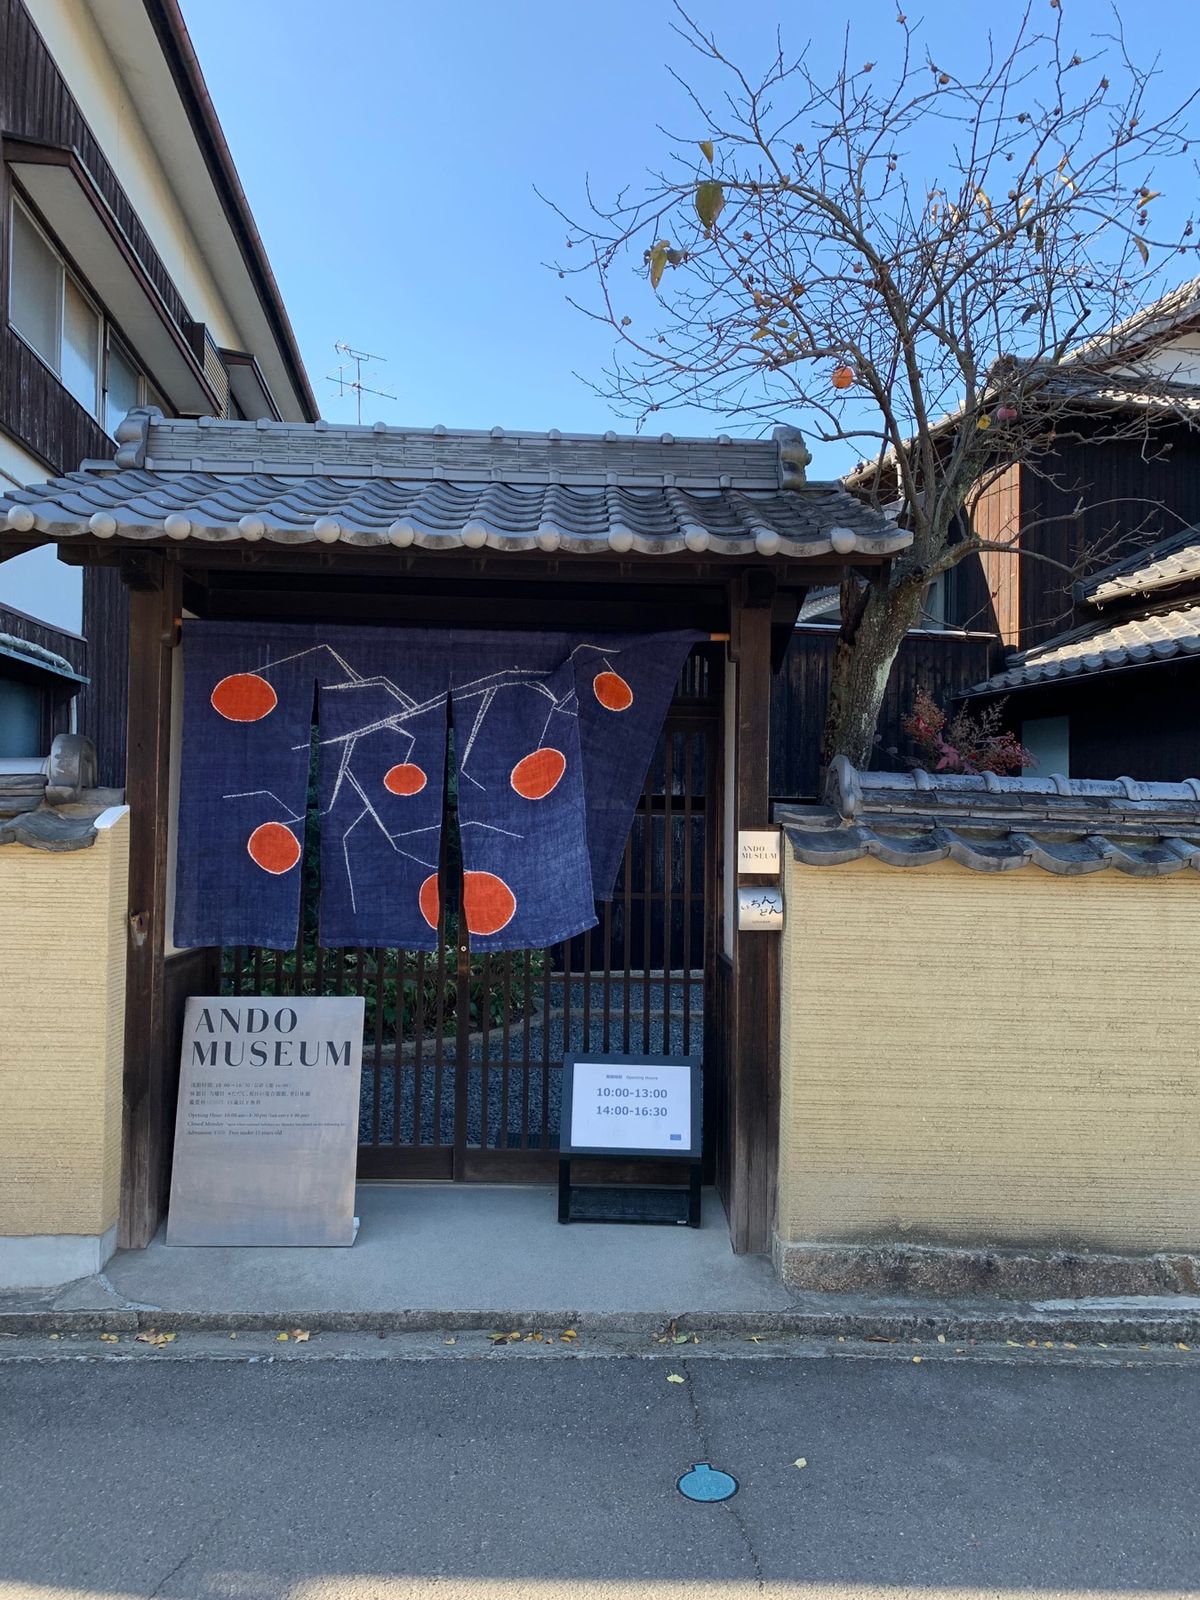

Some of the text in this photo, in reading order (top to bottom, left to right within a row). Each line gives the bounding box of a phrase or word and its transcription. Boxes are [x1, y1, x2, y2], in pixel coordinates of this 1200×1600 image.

[195, 1008, 298, 1033] ANDO
[191, 1041, 351, 1066] MUSEUM
[596, 1087, 668, 1099] 10:00-13:00
[596, 1105, 668, 1117] 14:00-16:30
